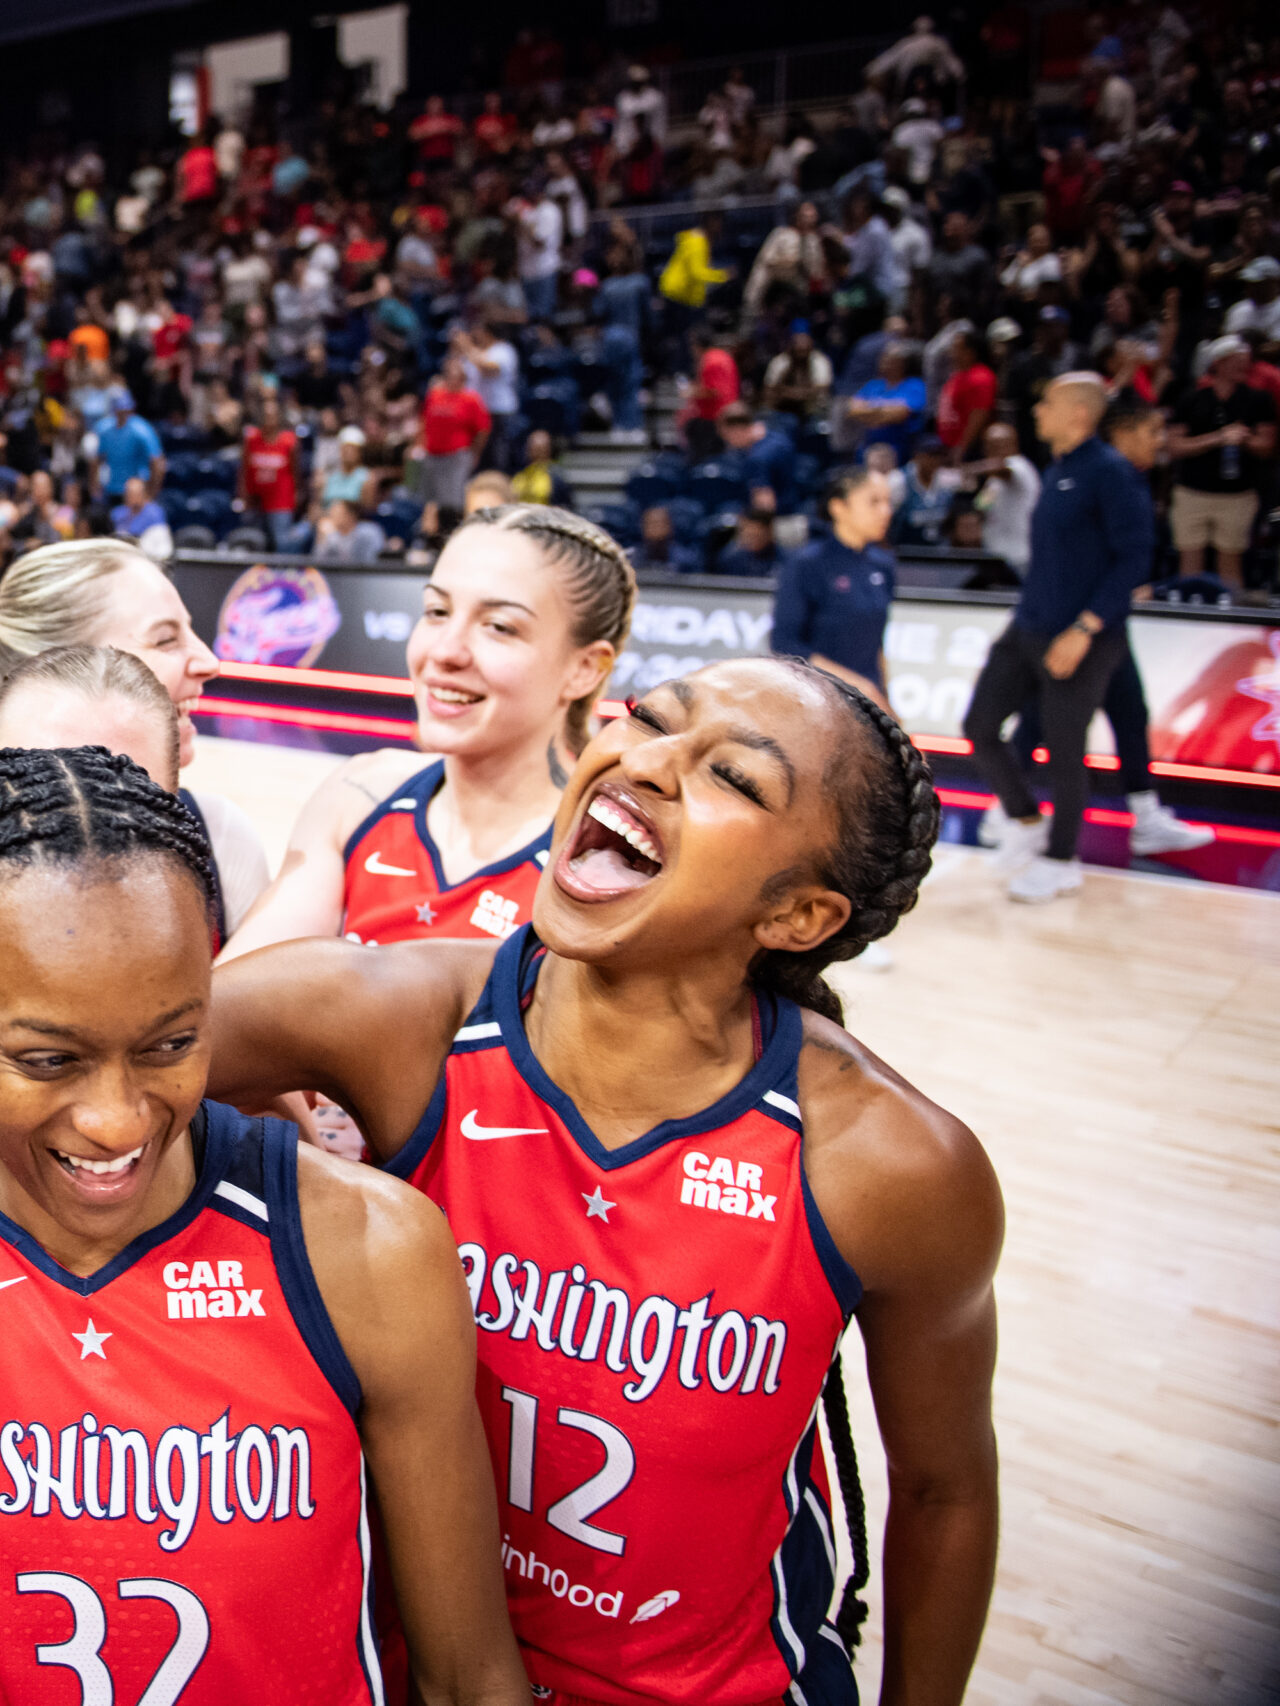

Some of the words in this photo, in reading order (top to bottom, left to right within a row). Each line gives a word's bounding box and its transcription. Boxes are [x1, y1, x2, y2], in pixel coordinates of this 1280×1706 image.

[682, 1151, 763, 1191] CAR
[680, 1178, 777, 1221] max
[162, 1259, 244, 1290] CAR
[166, 1288, 267, 1319] max
[501, 1386, 636, 1557] 12
[16, 1570, 211, 1706] 32
